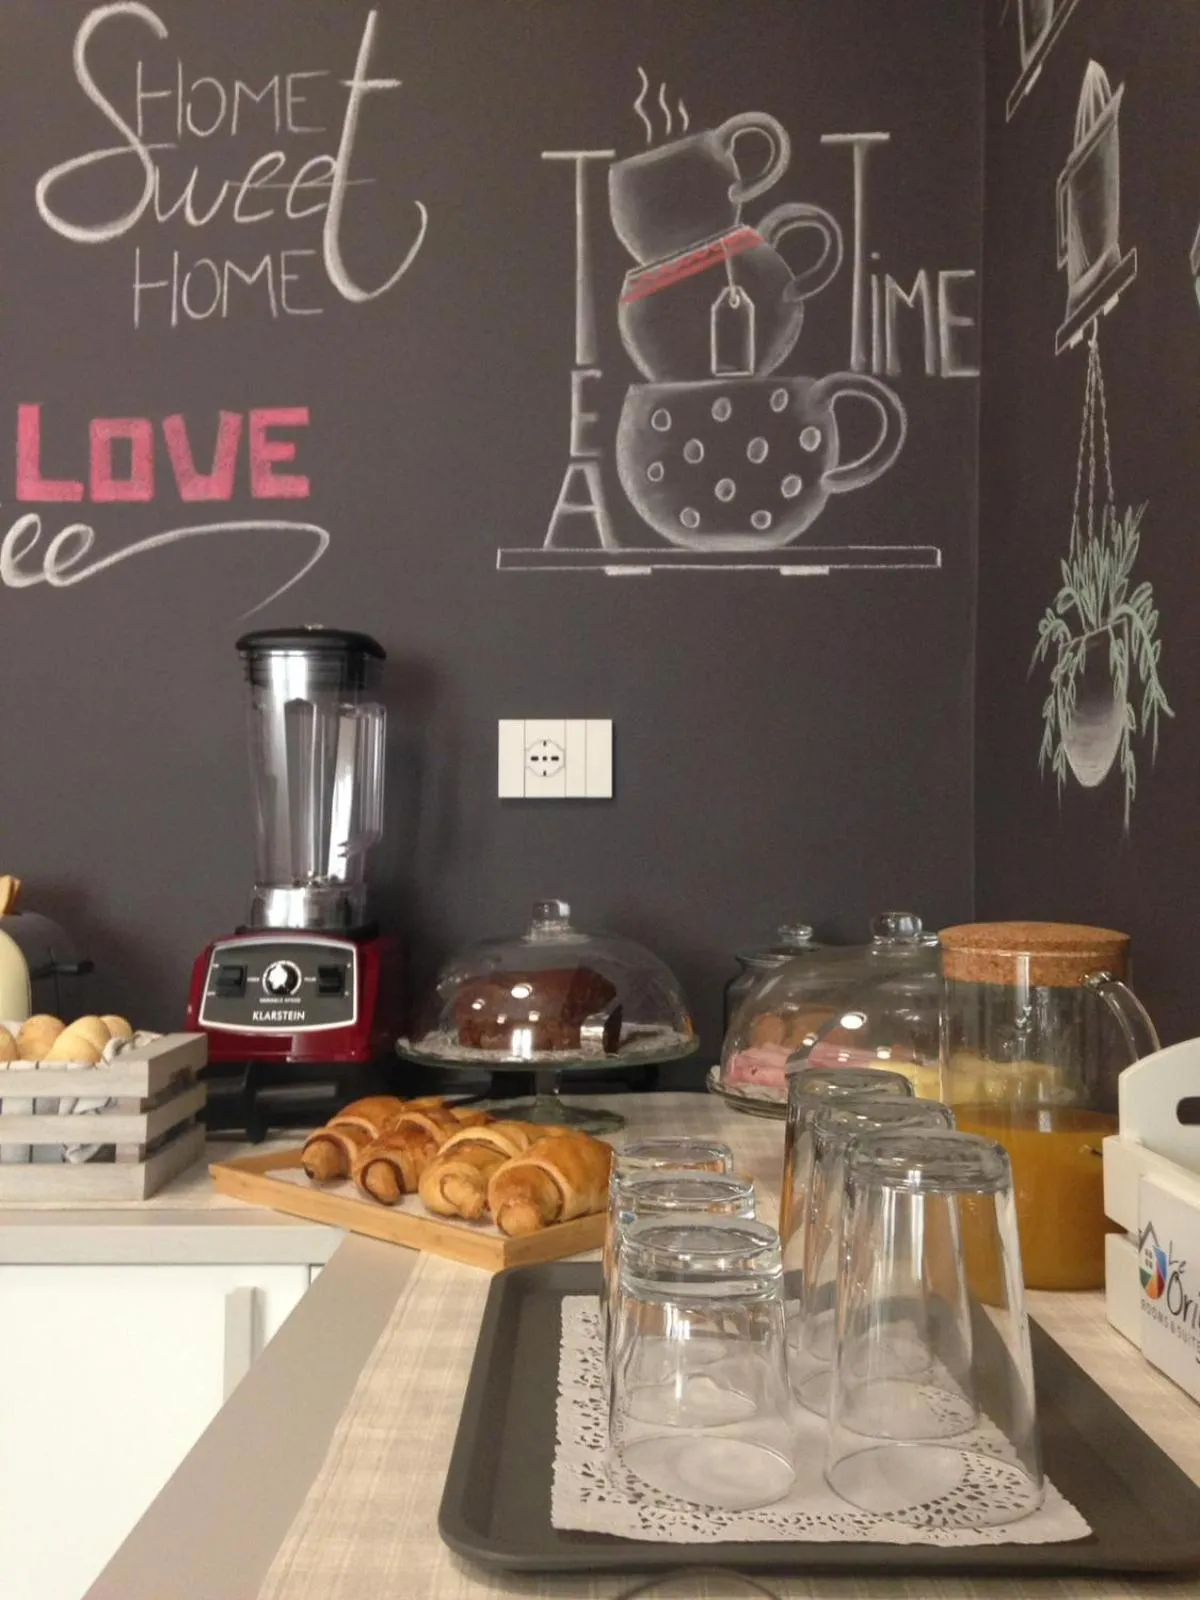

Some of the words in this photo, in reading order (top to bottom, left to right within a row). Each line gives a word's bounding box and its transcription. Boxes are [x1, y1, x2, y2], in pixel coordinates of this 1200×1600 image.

[136, 58, 331, 139] HOME
[36, 1, 428, 302] Sweet
[133, 246, 324, 330] HOME
[541, 149, 620, 551] TEA
[16, 403, 310, 503] LOVE
[252, 1010, 305, 1021] KLARSTEIN
